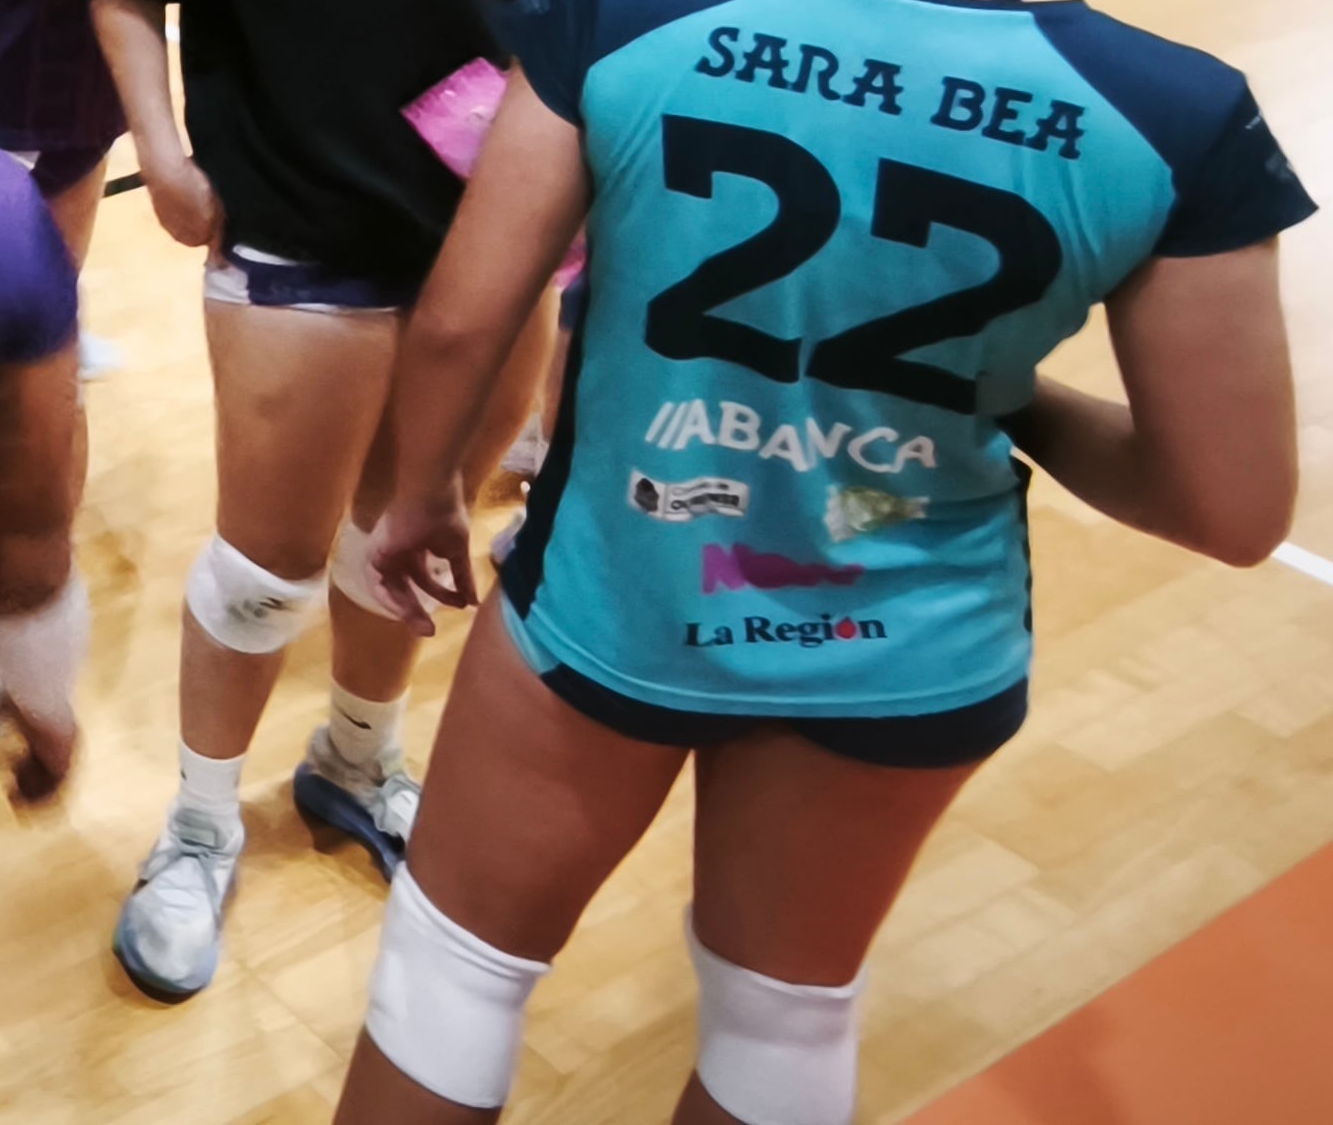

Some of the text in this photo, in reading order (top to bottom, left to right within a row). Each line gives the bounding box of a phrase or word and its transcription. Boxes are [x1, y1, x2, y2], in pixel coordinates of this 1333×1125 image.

[694, 26, 1086, 161] SARA BEA
[642, 113, 1064, 416] 22
[685, 622, 733, 648] La
